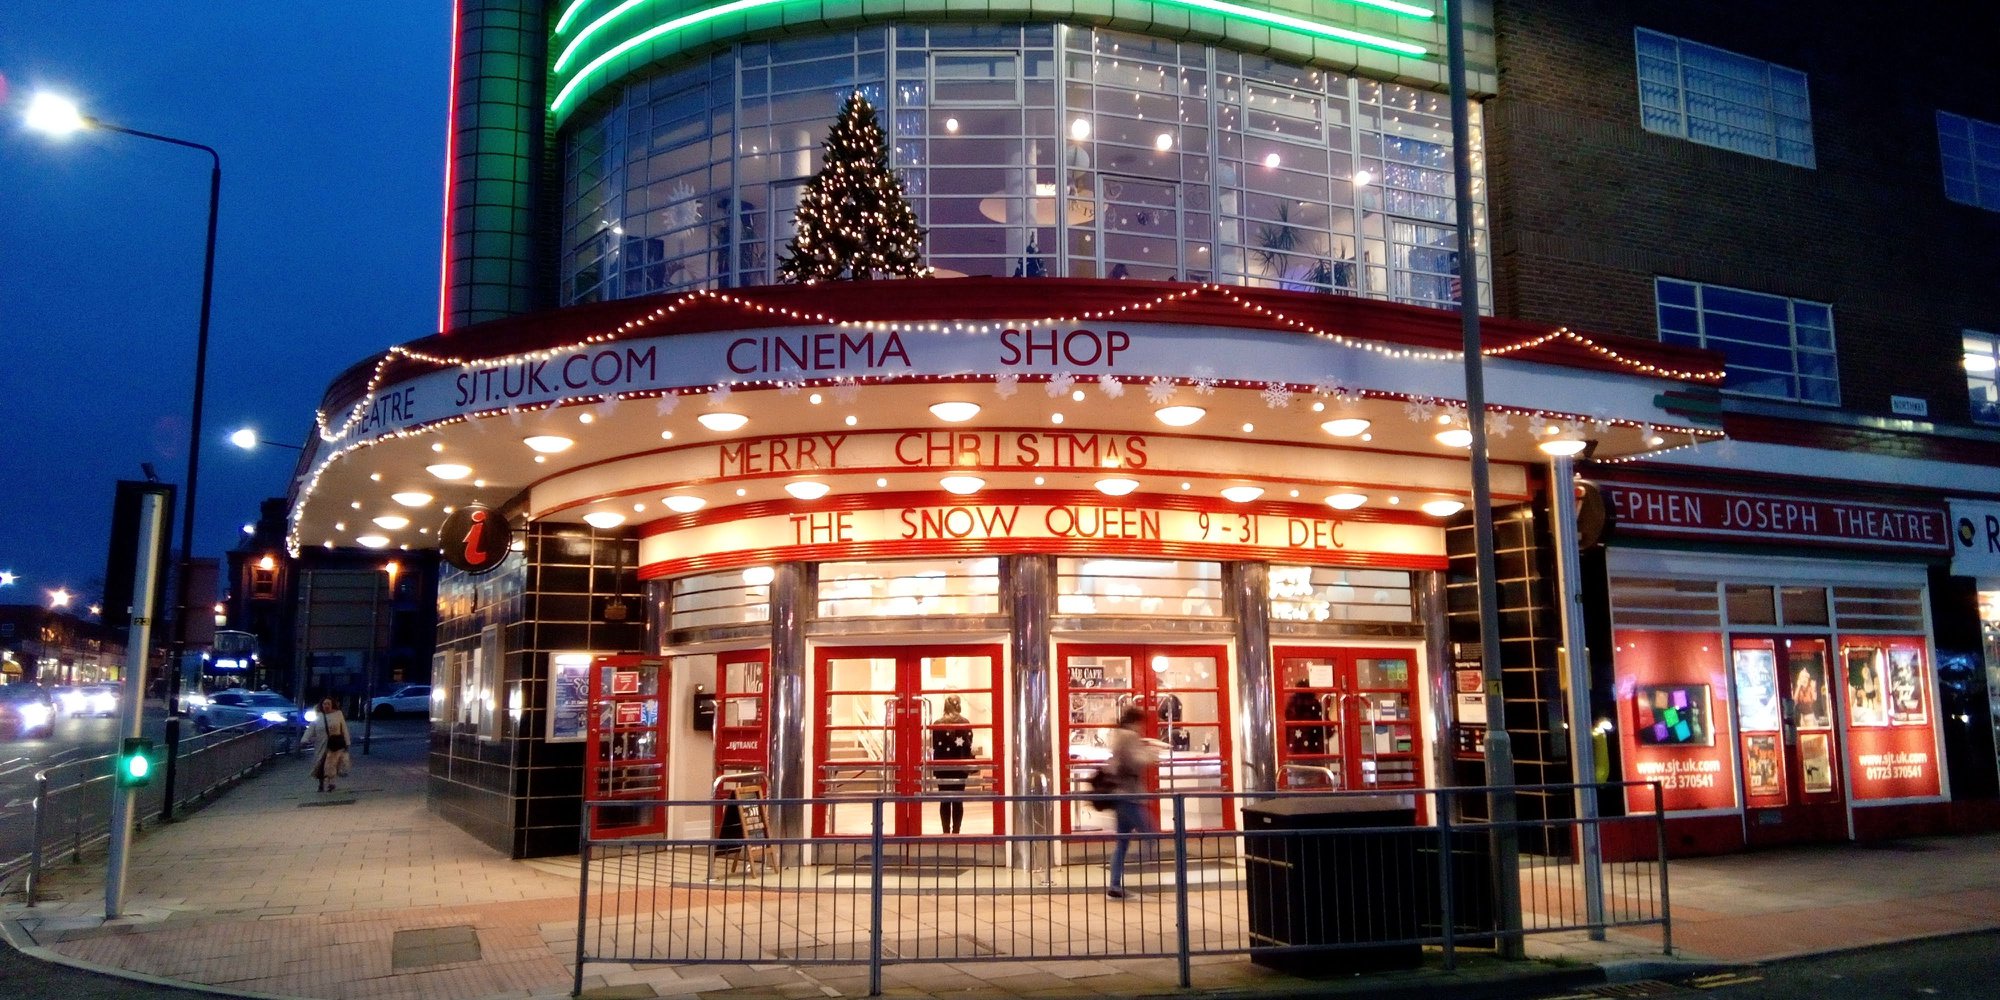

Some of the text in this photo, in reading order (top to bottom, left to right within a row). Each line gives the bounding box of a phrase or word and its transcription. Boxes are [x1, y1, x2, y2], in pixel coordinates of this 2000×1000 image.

[455, 346, 657, 407] SJT.UK.COM
[726, 330, 912, 375] CINEMA
[1000, 329, 1131, 367] SHOP
[720, 431, 1148, 478] MERRY CHRISTMAS
[789, 512, 854, 546] THE
[901, 507, 1020, 540] SNOW
[1045, 505, 1161, 541] QUEEN
[1287, 518, 1345, 549] DEC
[1612, 490, 1934, 541] EPHEN JOSEPH THEATRE
[1636, 758, 1721, 774] www.sjt.uk.com
[1859, 751, 1928, 768] www.sjt.uk.com
[1866, 765, 1922, 780] 01723 370541
[1678, 773, 1714, 789] 370541
